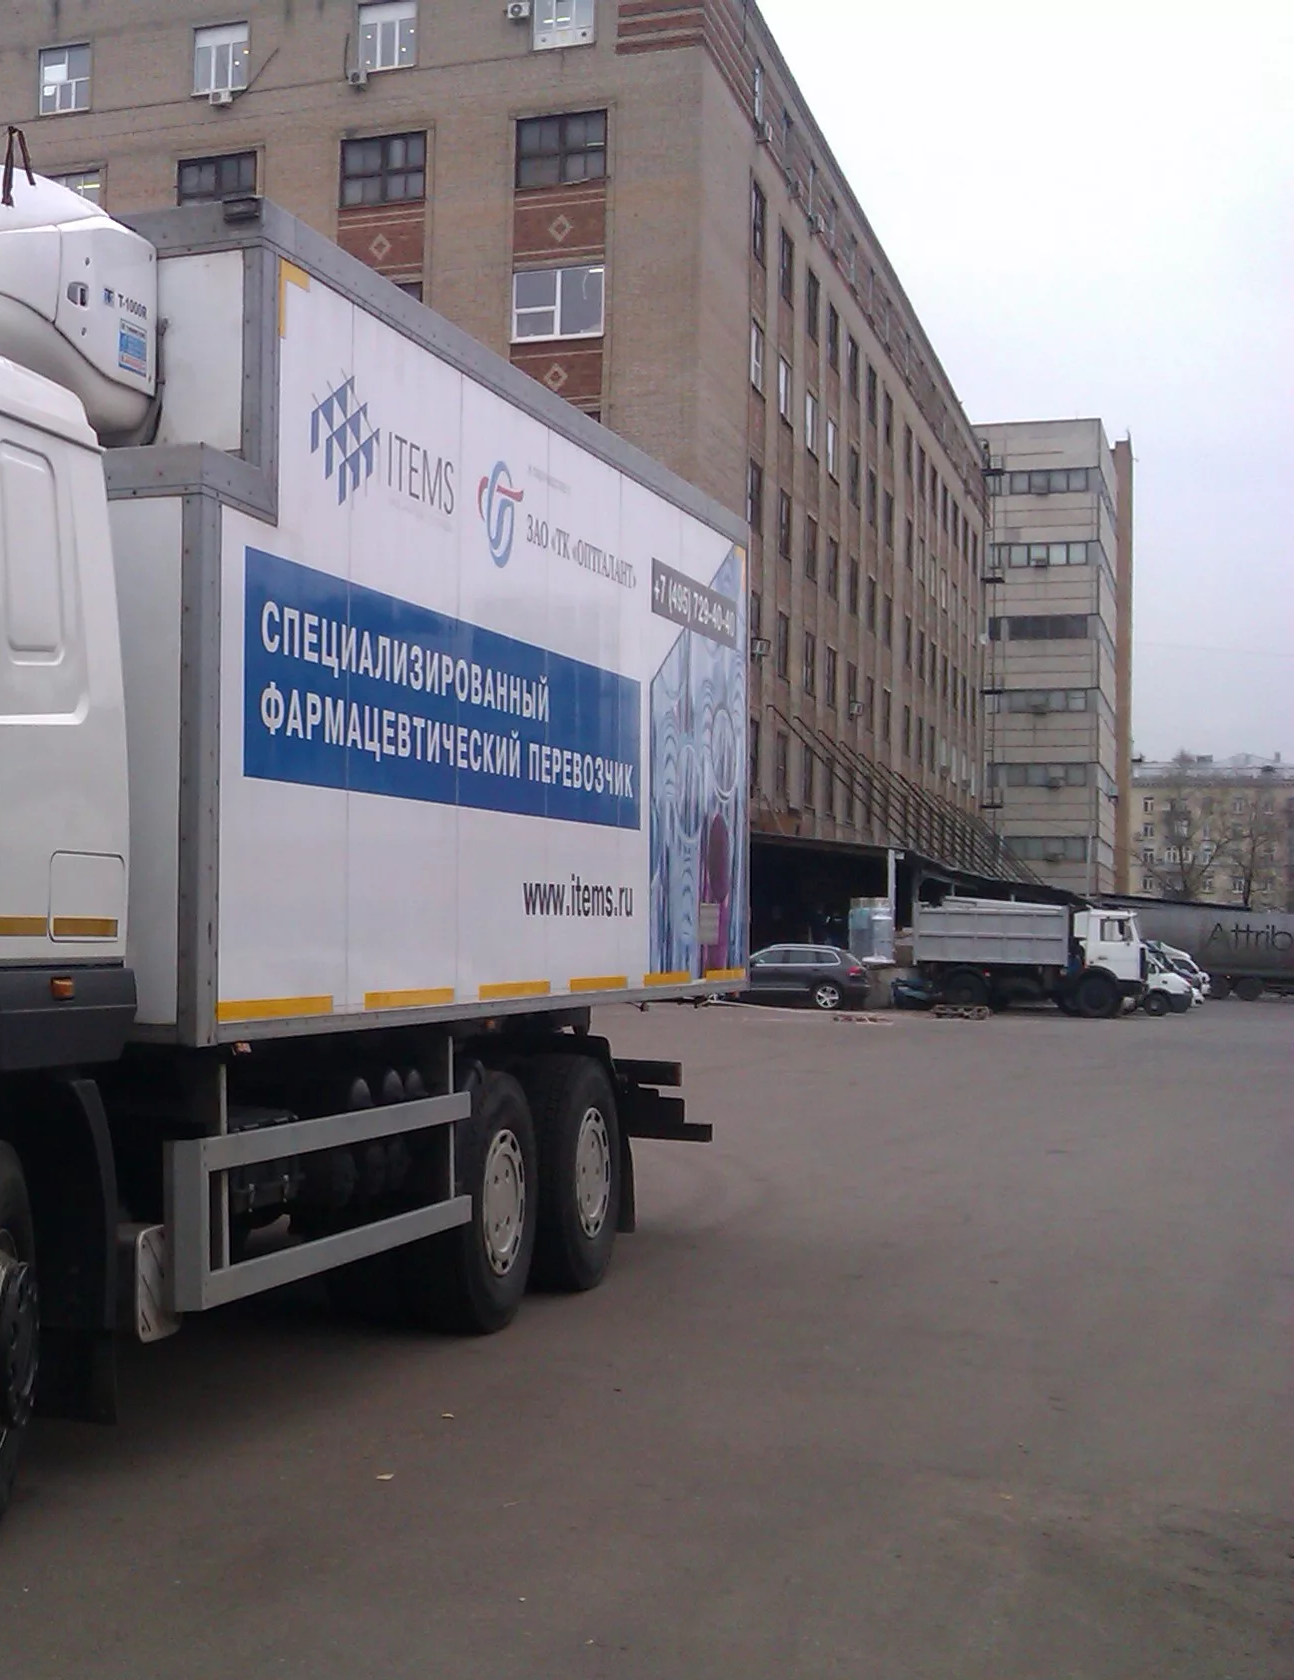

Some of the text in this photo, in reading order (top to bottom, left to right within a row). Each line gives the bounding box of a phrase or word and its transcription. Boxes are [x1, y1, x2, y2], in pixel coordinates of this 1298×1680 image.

[388, 431, 455, 516] ITEMS
[526, 513, 549, 549] ЗАО
[654, 574, 666, 604] +7
[669, 577, 691, 623] (495)
[260, 599, 550, 723] СПЕЦИАЛИЗИРОВАННЫЙ
[260, 681, 635, 799] ФАРМАЦЕВТИЧЕСКИЙ ПЕРЕВОЗЧИК
[523, 873, 633, 918] www.items.ru
